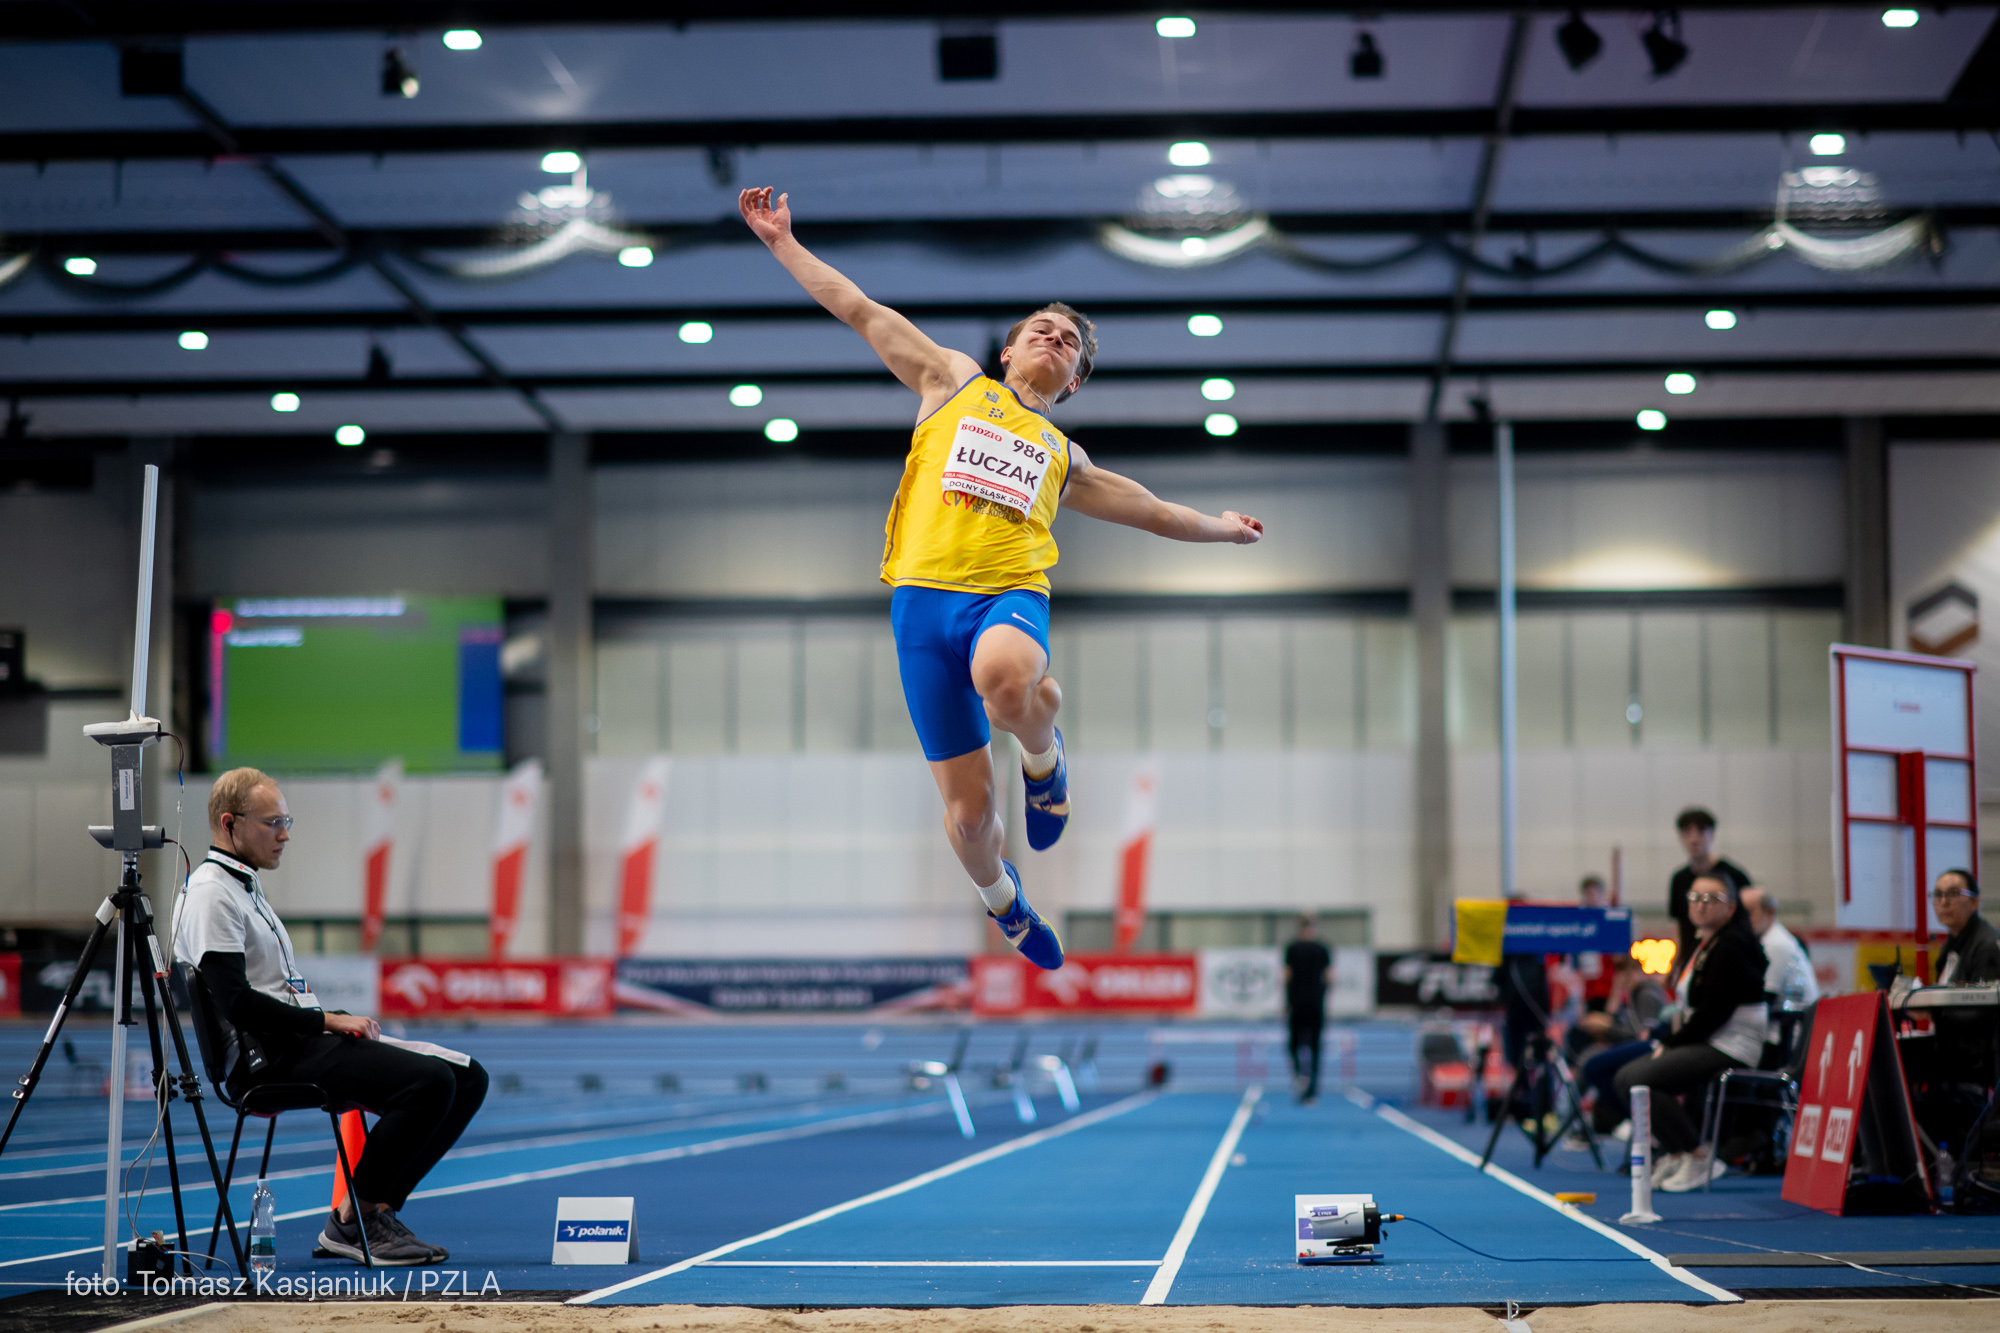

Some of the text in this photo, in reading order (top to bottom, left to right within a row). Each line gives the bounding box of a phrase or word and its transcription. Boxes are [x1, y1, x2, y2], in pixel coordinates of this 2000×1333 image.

[960, 423, 1003, 442] BODZIO
[1012, 439, 1046, 465] 986
[956, 446, 1039, 491] ŁUCZAK
[949, 480, 1028, 511] DOLNY ŚLĄSK 2024
[1029, 790, 1050, 804] NIKE
[577, 1225, 624, 1238] polanik
